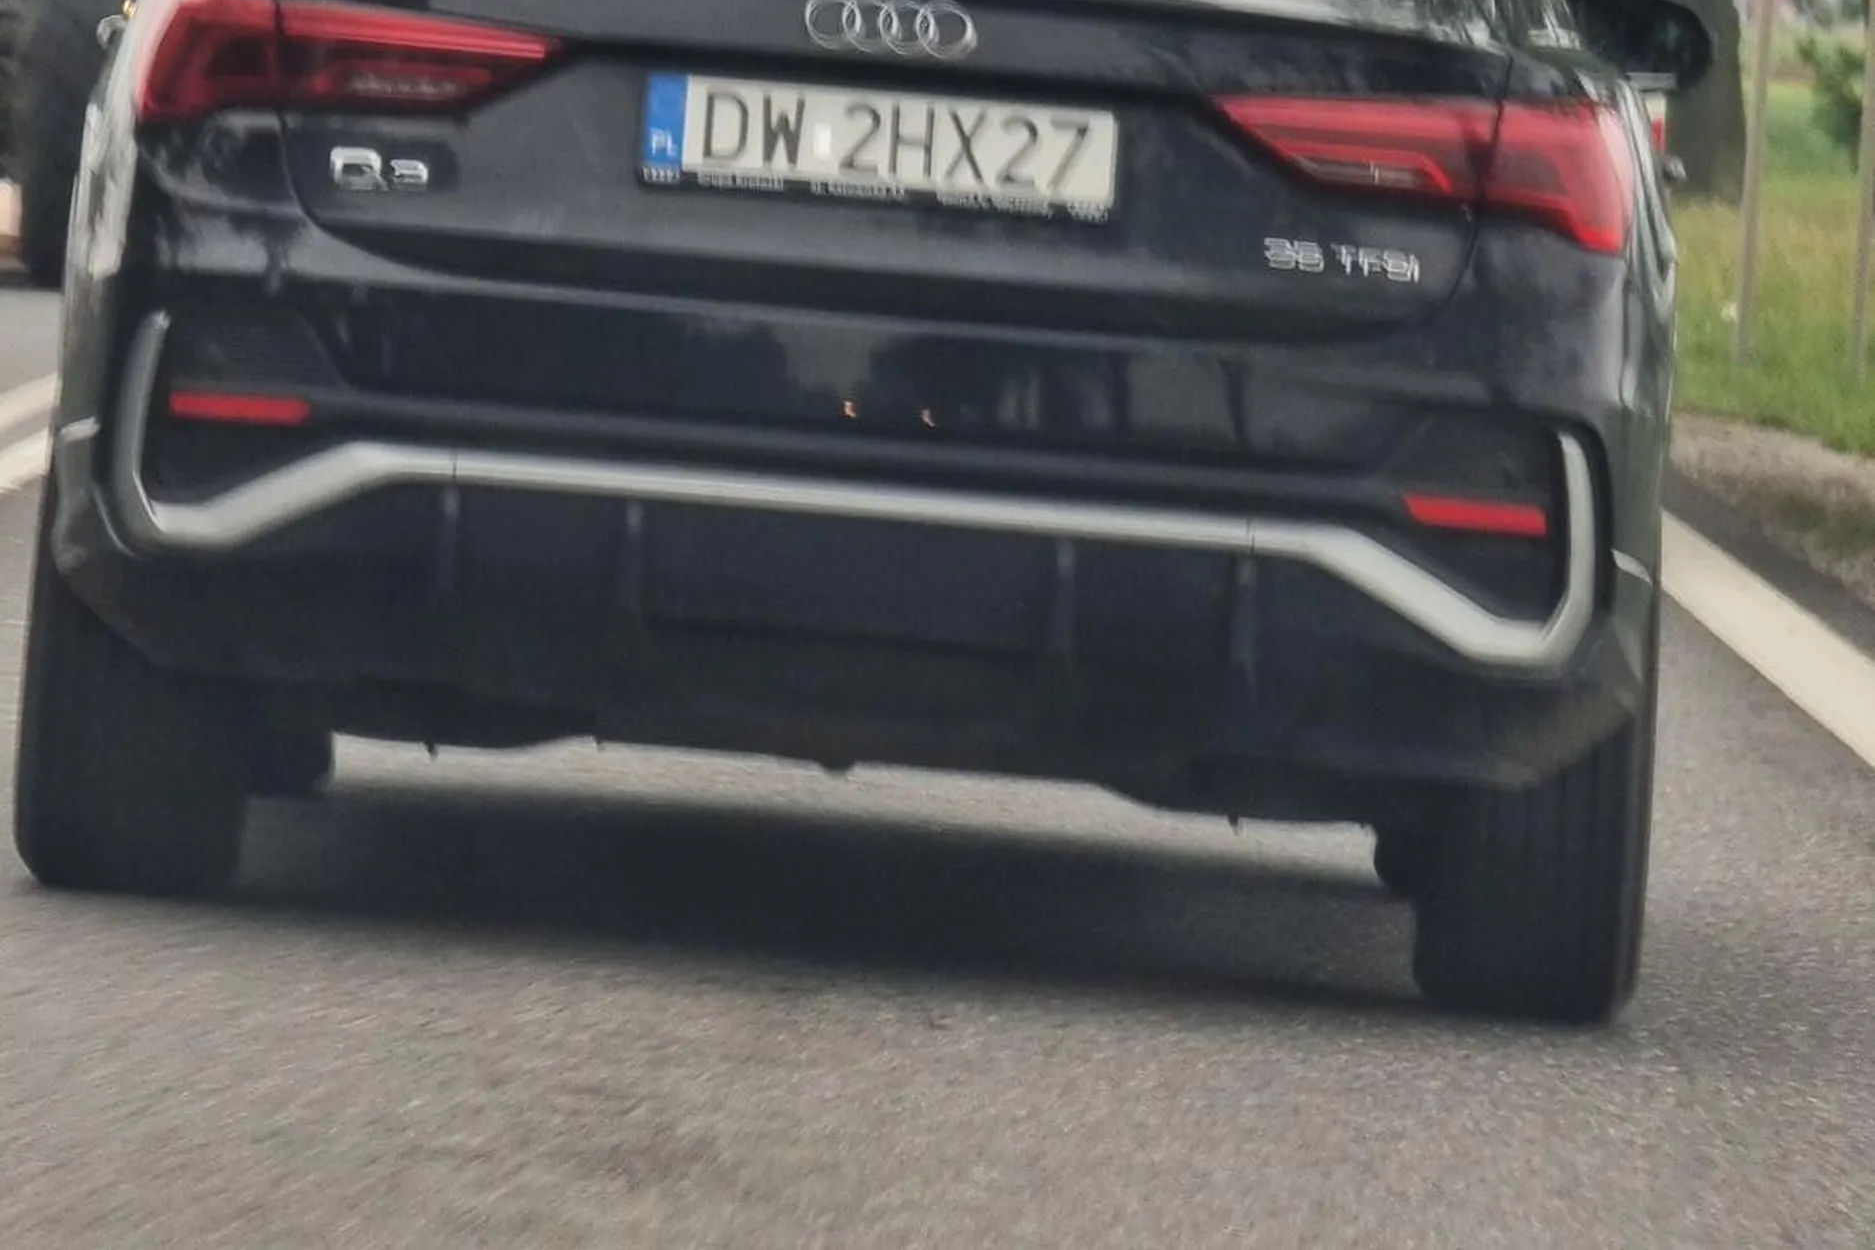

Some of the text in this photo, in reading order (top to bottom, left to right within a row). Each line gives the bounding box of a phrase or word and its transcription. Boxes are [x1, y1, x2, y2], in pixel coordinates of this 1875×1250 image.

[330, 146, 428, 191] Q3
[650, 89, 1091, 191] PL DW 2HX27
